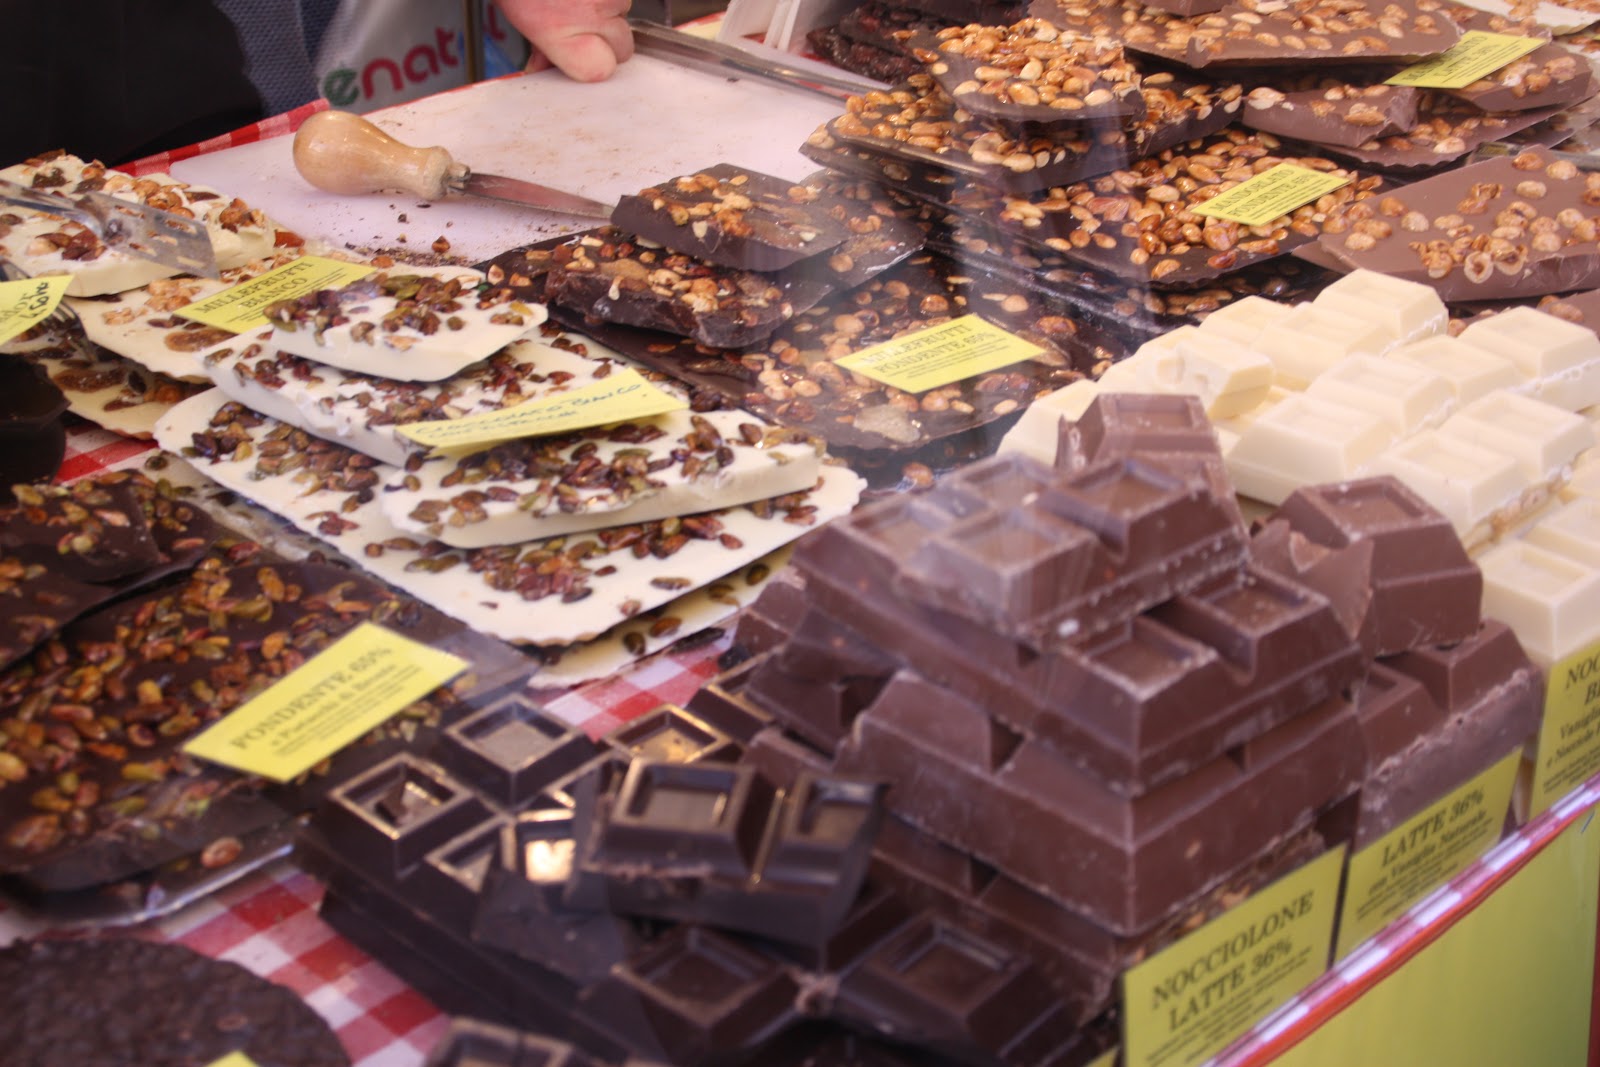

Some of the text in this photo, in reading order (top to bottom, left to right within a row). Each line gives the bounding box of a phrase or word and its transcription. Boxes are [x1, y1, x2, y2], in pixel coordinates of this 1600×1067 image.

[323, 3, 506, 107] enatl
[1209, 169, 1295, 211] MANDORLATO
[1227, 181, 1297, 217] FONDENTE
[194, 261, 314, 313] MILLEFRUTTI
[240, 277, 308, 309] BIANCO
[861, 324, 972, 363] MILLEFRUTTI
[874, 340, 966, 373] FONDENTE
[229, 669, 353, 749] FONDENTE
[1381, 808, 1447, 867] LATTE
[1152, 889, 1314, 1010] NOCCIOLONE
[1169, 962, 1246, 1031] LATTE
